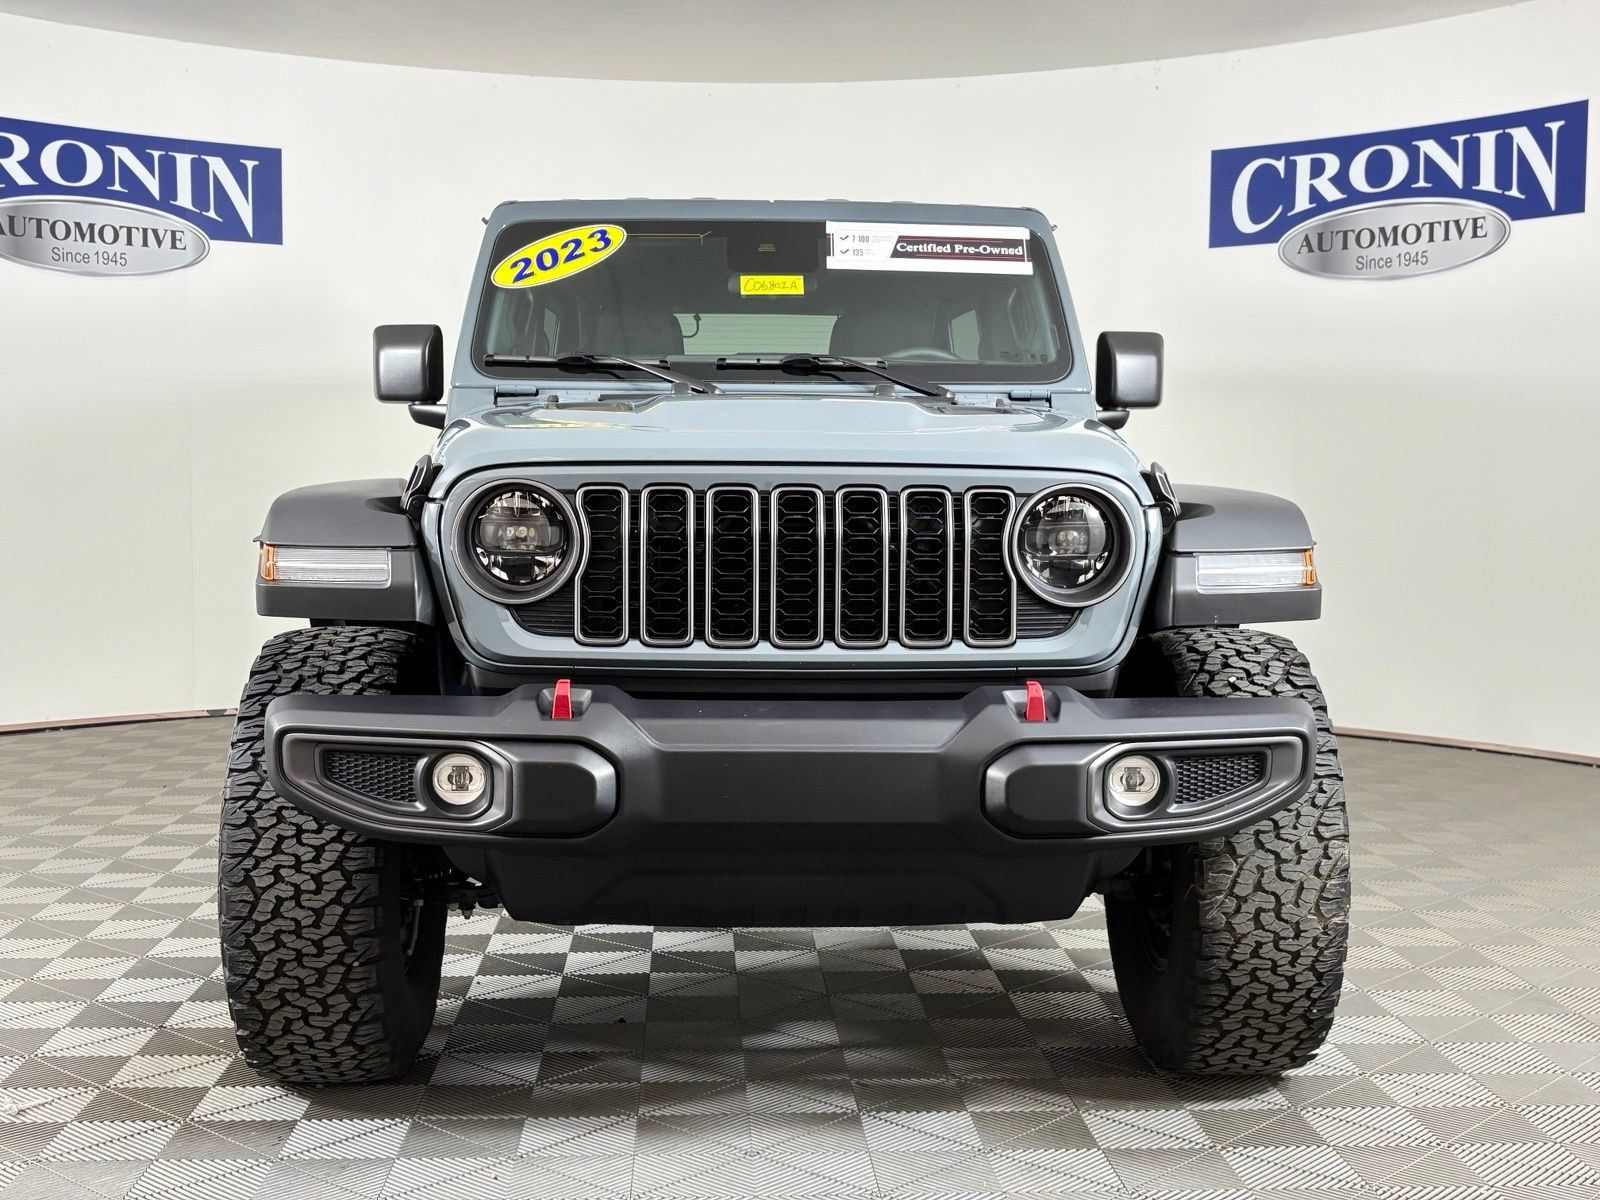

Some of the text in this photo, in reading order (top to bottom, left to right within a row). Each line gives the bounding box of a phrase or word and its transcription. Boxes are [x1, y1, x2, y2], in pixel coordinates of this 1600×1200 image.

[1231, 119, 1566, 235] CRONIN
[896, 242, 1024, 256] Certified Pre-Owned
[1296, 215, 1489, 255] AUTOMOTIVE
[51, 246, 128, 267] Since 1945
[509, 228, 612, 284] 2023
[1355, 250, 1429, 271] Since 1945
